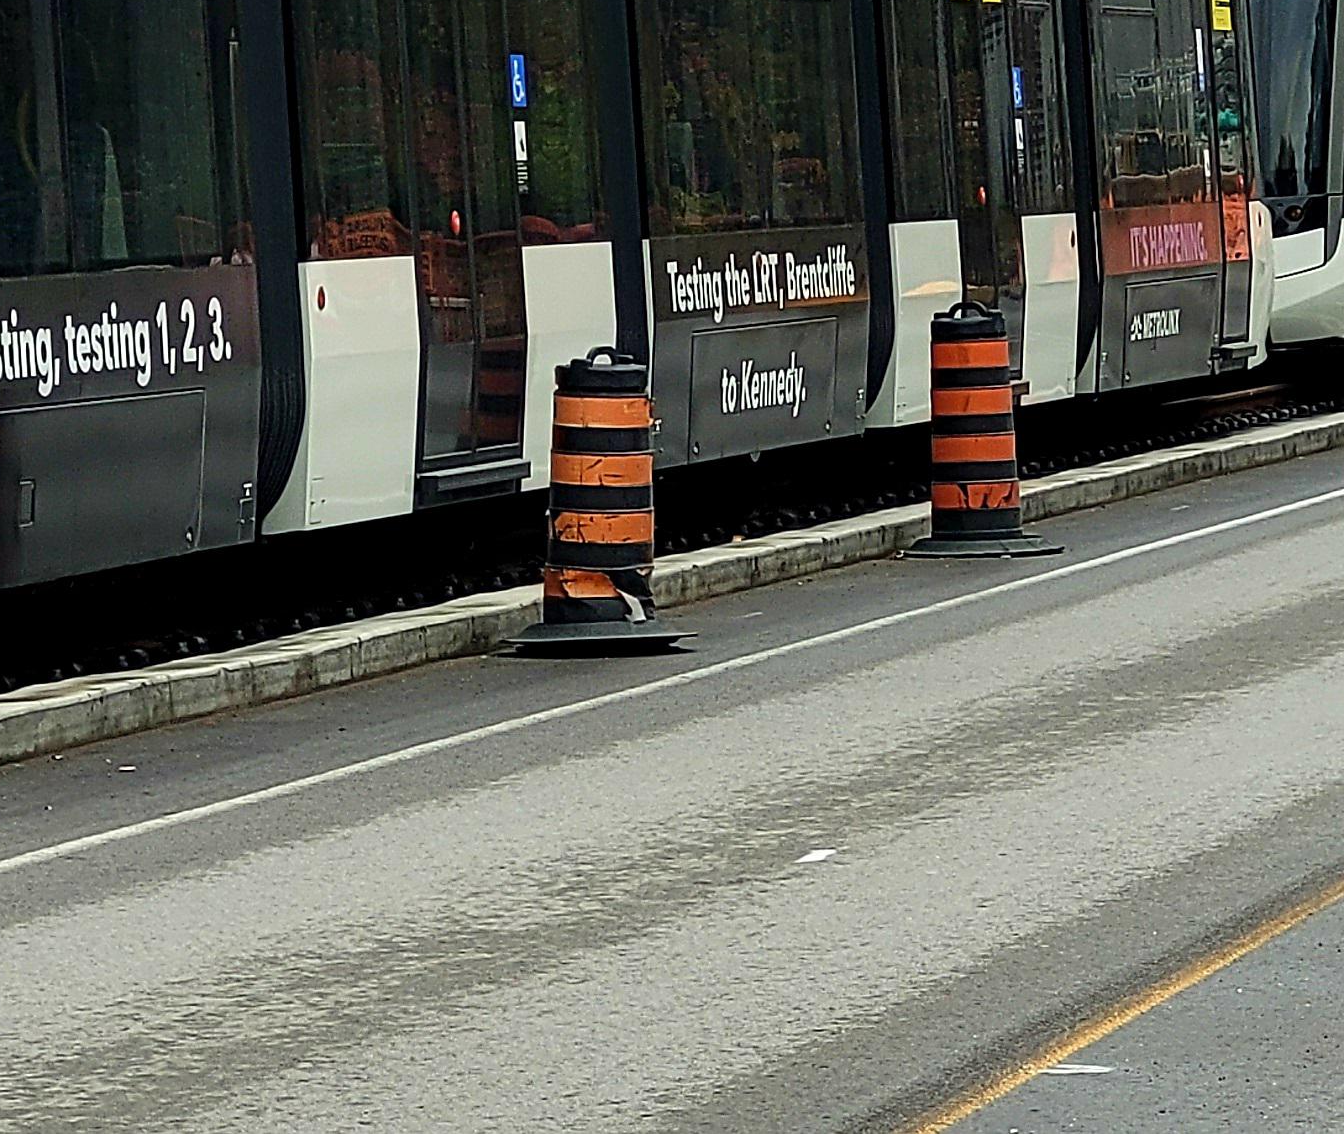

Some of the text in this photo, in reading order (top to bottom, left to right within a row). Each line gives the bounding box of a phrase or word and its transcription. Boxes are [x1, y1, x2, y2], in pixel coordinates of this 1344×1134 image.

[666, 245, 857, 323] Testing the LRT, Brentcliffe
[64, 301, 152, 387] testing
[156, 301, 176, 374] 1,
[180, 298, 204, 372] 2,
[208, 296, 232, 362] 3.
[721, 350, 806, 418] to Kennedy.
